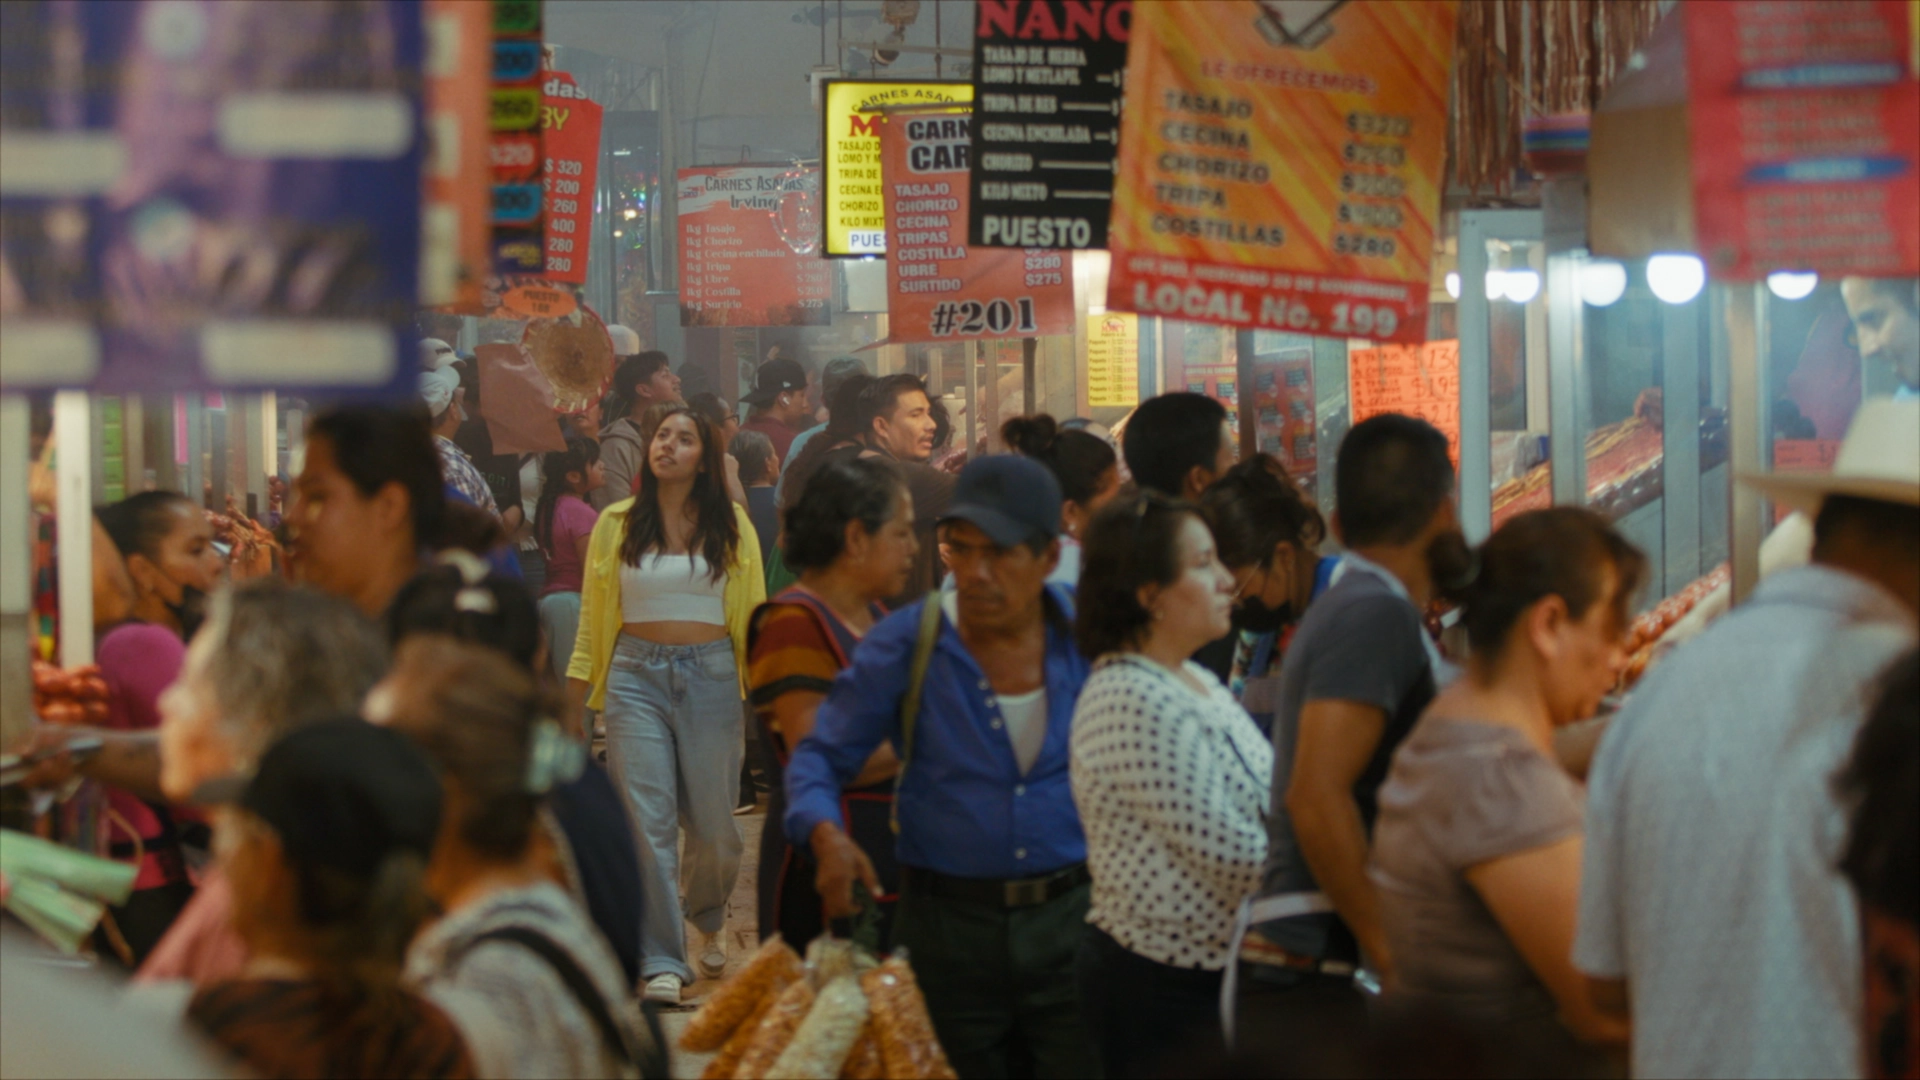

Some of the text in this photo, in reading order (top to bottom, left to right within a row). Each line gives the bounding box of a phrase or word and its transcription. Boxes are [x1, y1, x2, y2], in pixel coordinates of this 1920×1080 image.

[1028, 46, 1045, 65] DE
[982, 65, 1015, 84] LOMO
[1202, 60, 1230, 79] LE
[543, 78, 587, 100] das
[851, 88, 909, 113] CARNES
[982, 94, 1017, 113] TRIPA
[1017, 94, 1033, 113] DE
[1034, 95, 1058, 114] RES
[1164, 88, 1254, 120] TASAJO
[982, 123, 1025, 142] CECINA
[1025, 124, 1091, 144] ENCHILADA
[1160, 120, 1251, 150] CECINA
[838, 141, 872, 151] TASAJO
[838, 153, 863, 164] LOMO
[866, 154, 872, 163] Y
[981, 152, 1034, 172] CHORIZO
[557, 159, 582, 176] 320
[839, 169, 878, 180] TRIPA DE
[1157, 151, 1271, 184] CHORIZO
[555, 179, 580, 195] 200
[840, 185, 872, 195] CECINA
[894, 183, 950, 197] TASAJO
[981, 181, 1010, 201] KILO
[1154, 182, 1227, 209] TRIPA
[553, 198, 577, 215] 260
[730, 194, 779, 212] Irving
[840, 201, 879, 212] CHORIZO
[895, 198, 959, 213] CHORIZO
[551, 218, 576, 234] 400
[705, 224, 736, 234] Tasajo
[840, 217, 861, 228] KILO
[896, 215, 950, 229] CECINA
[1152, 213, 1285, 248] COSTILLAS
[897, 231, 948, 245] TRIPAS
[982, 214, 1092, 248] PUESTO
[548, 236, 574, 253] 280
[704, 237, 743, 246] Chorizo
[1332, 231, 1396, 259] $280
[704, 249, 737, 258] Cecina
[738, 248, 786, 258] enchilada
[898, 246, 966, 262] COSTILLA
[546, 256, 572, 272] 280
[705, 262, 731, 272] Tripa
[898, 256, 1062, 278] UBRE $280
[704, 275, 729, 284] Ubre
[900, 272, 1062, 293] SURTIDO $275
[523, 290, 561, 304] PUESTO
[704, 287, 741, 296] Costilla
[704, 300, 742, 309] Surtido
[1133, 281, 1398, 338] LOCAL No. 199
[931, 297, 1037, 337] #201
